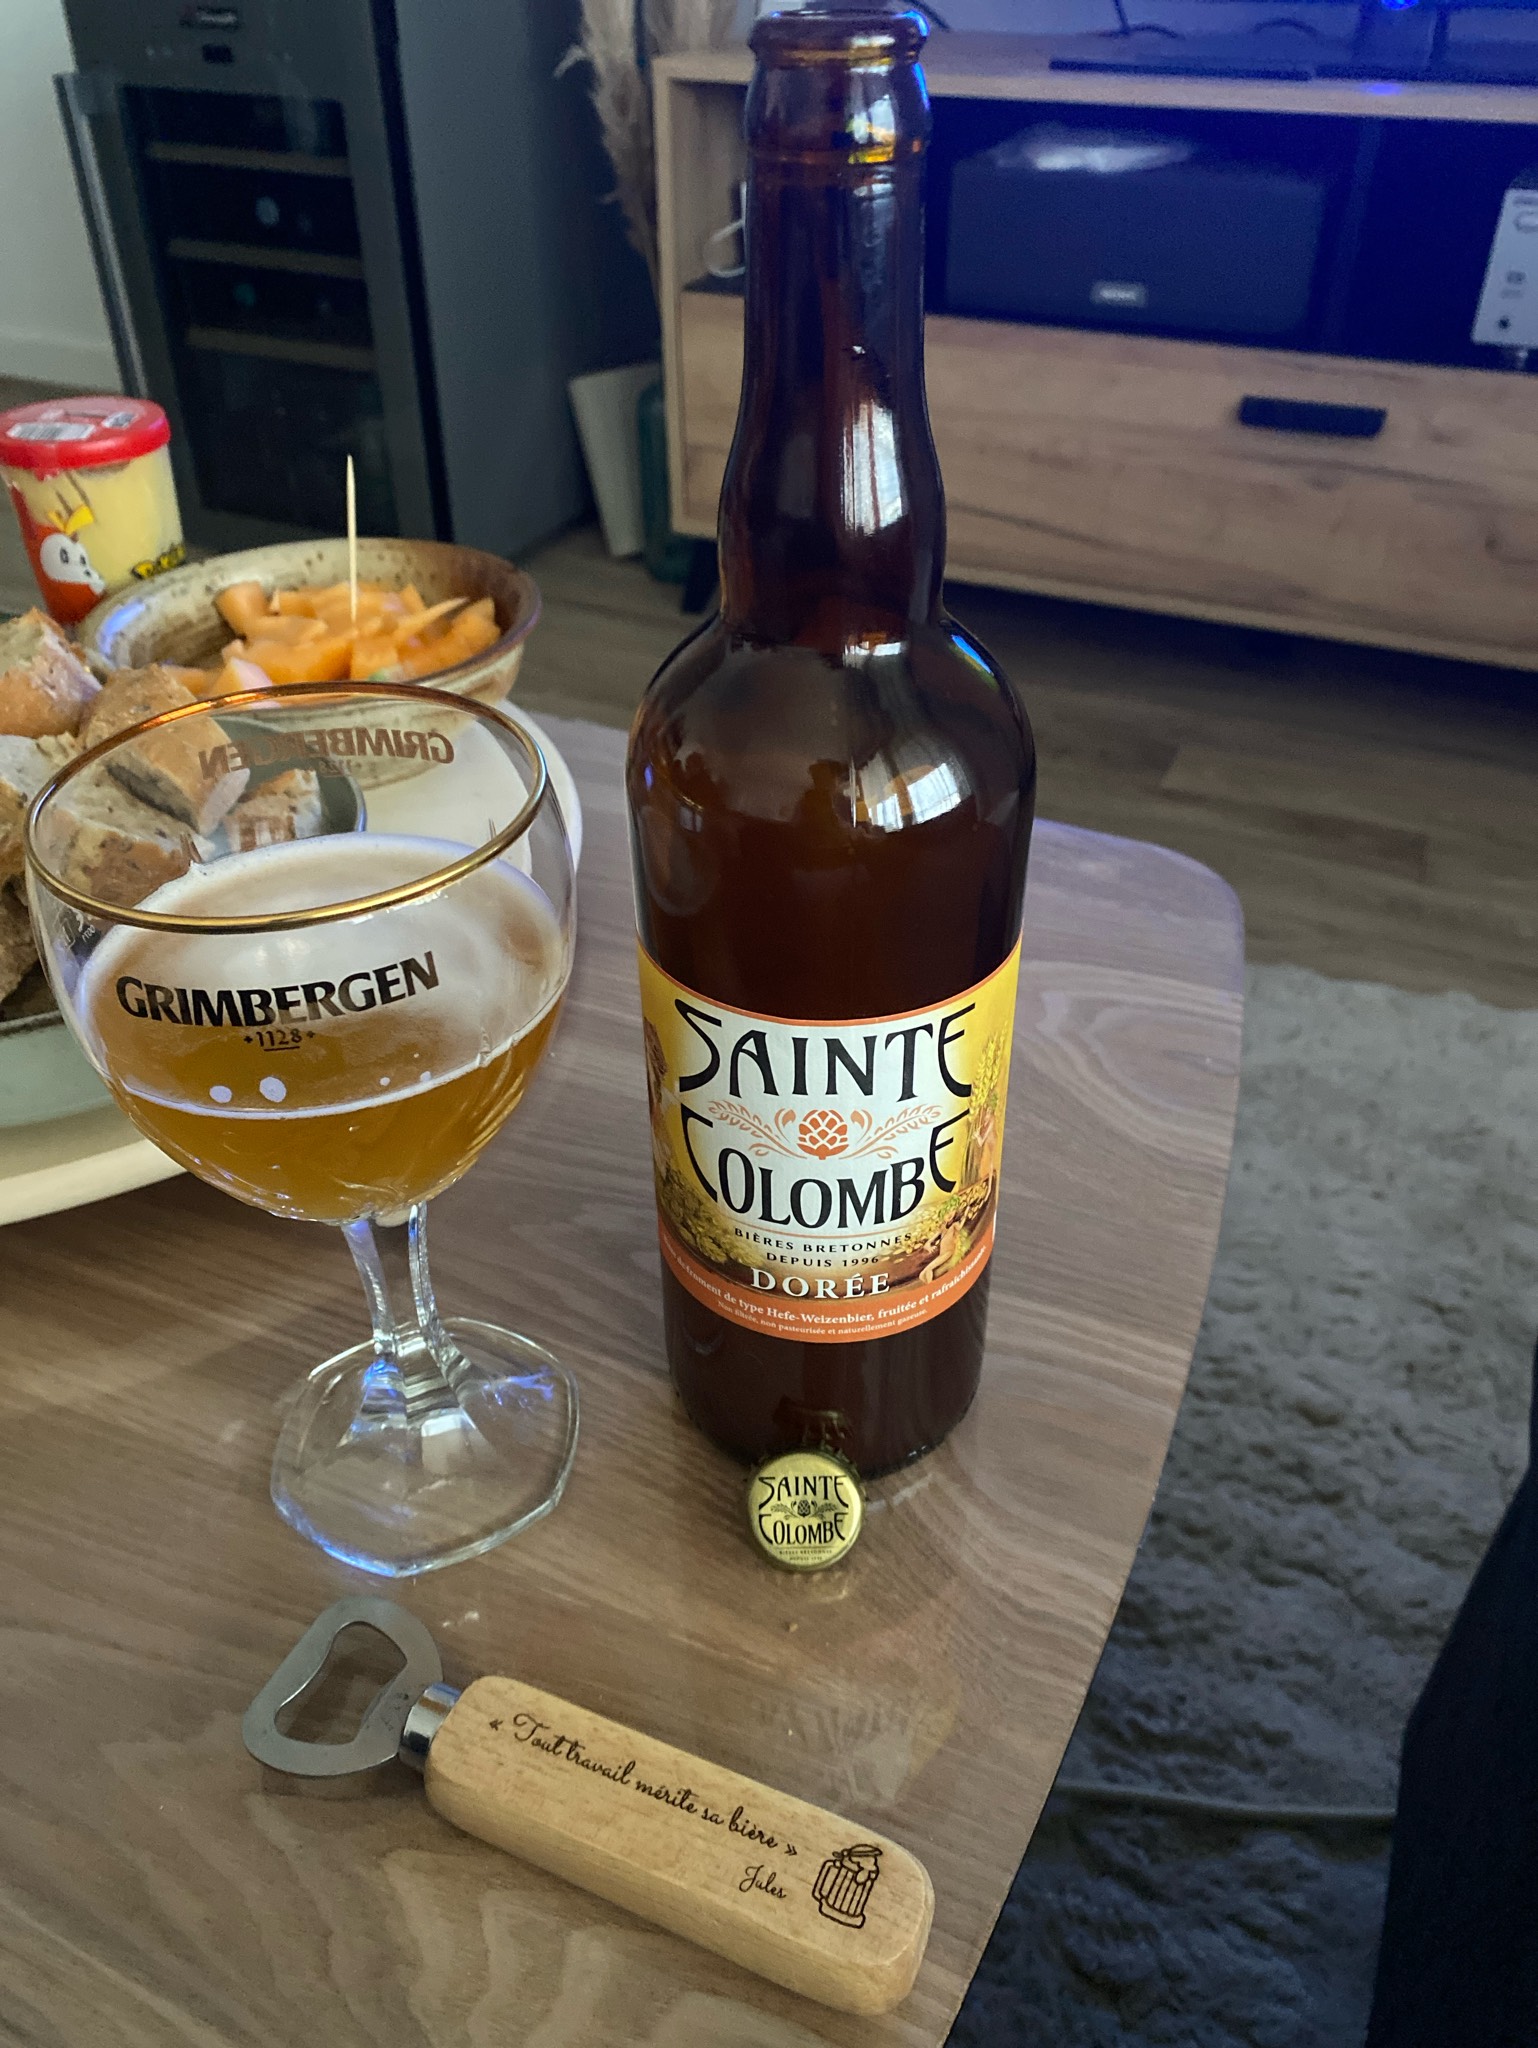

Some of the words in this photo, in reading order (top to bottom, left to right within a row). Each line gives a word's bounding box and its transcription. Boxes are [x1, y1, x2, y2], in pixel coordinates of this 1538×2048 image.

[115, 950, 440, 1027] GRIMBERGEN
[255, 1028, 303, 1048] 1128
[674, 998, 976, 1103] SAINTE
[680, 1102, 970, 1229] COLOMBE
[735, 1227, 794, 1250] BIÈRES
[803, 1232, 912, 1253] BRETONNES
[766, 1252, 832, 1267] DEPUIS
[843, 1256, 879, 1267] 1996
[686, 1265, 722, 1297] froment
[724, 1292, 737, 1304] de
[739, 1299, 764, 1314] type
[766, 1307, 875, 1324] Hefe-Weizenbier,
[877, 1301, 917, 1319] fruitée
[918, 1294, 930, 1305] et
[750, 1267, 891, 1300] DORÉE
[718, 1301, 733, 1314] Non
[734, 1307, 759, 1324] filtrée,
[760, 1319, 777, 1328] non
[778, 1324, 826, 1334] pasteurisée
[837, 1320, 896, 1335] naturellement
[758, 1475, 849, 1511] SAINTE
[758, 1512, 849, 1546] COLOMBE
[513, 1713, 565, 1756] Tout
[564, 1738, 637, 1785] travail
[635, 1780, 700, 1814] mérite
[701, 1807, 724, 1826] sa
[728, 1806, 778, 1849] bière
[738, 1864, 788, 1899] Jules
